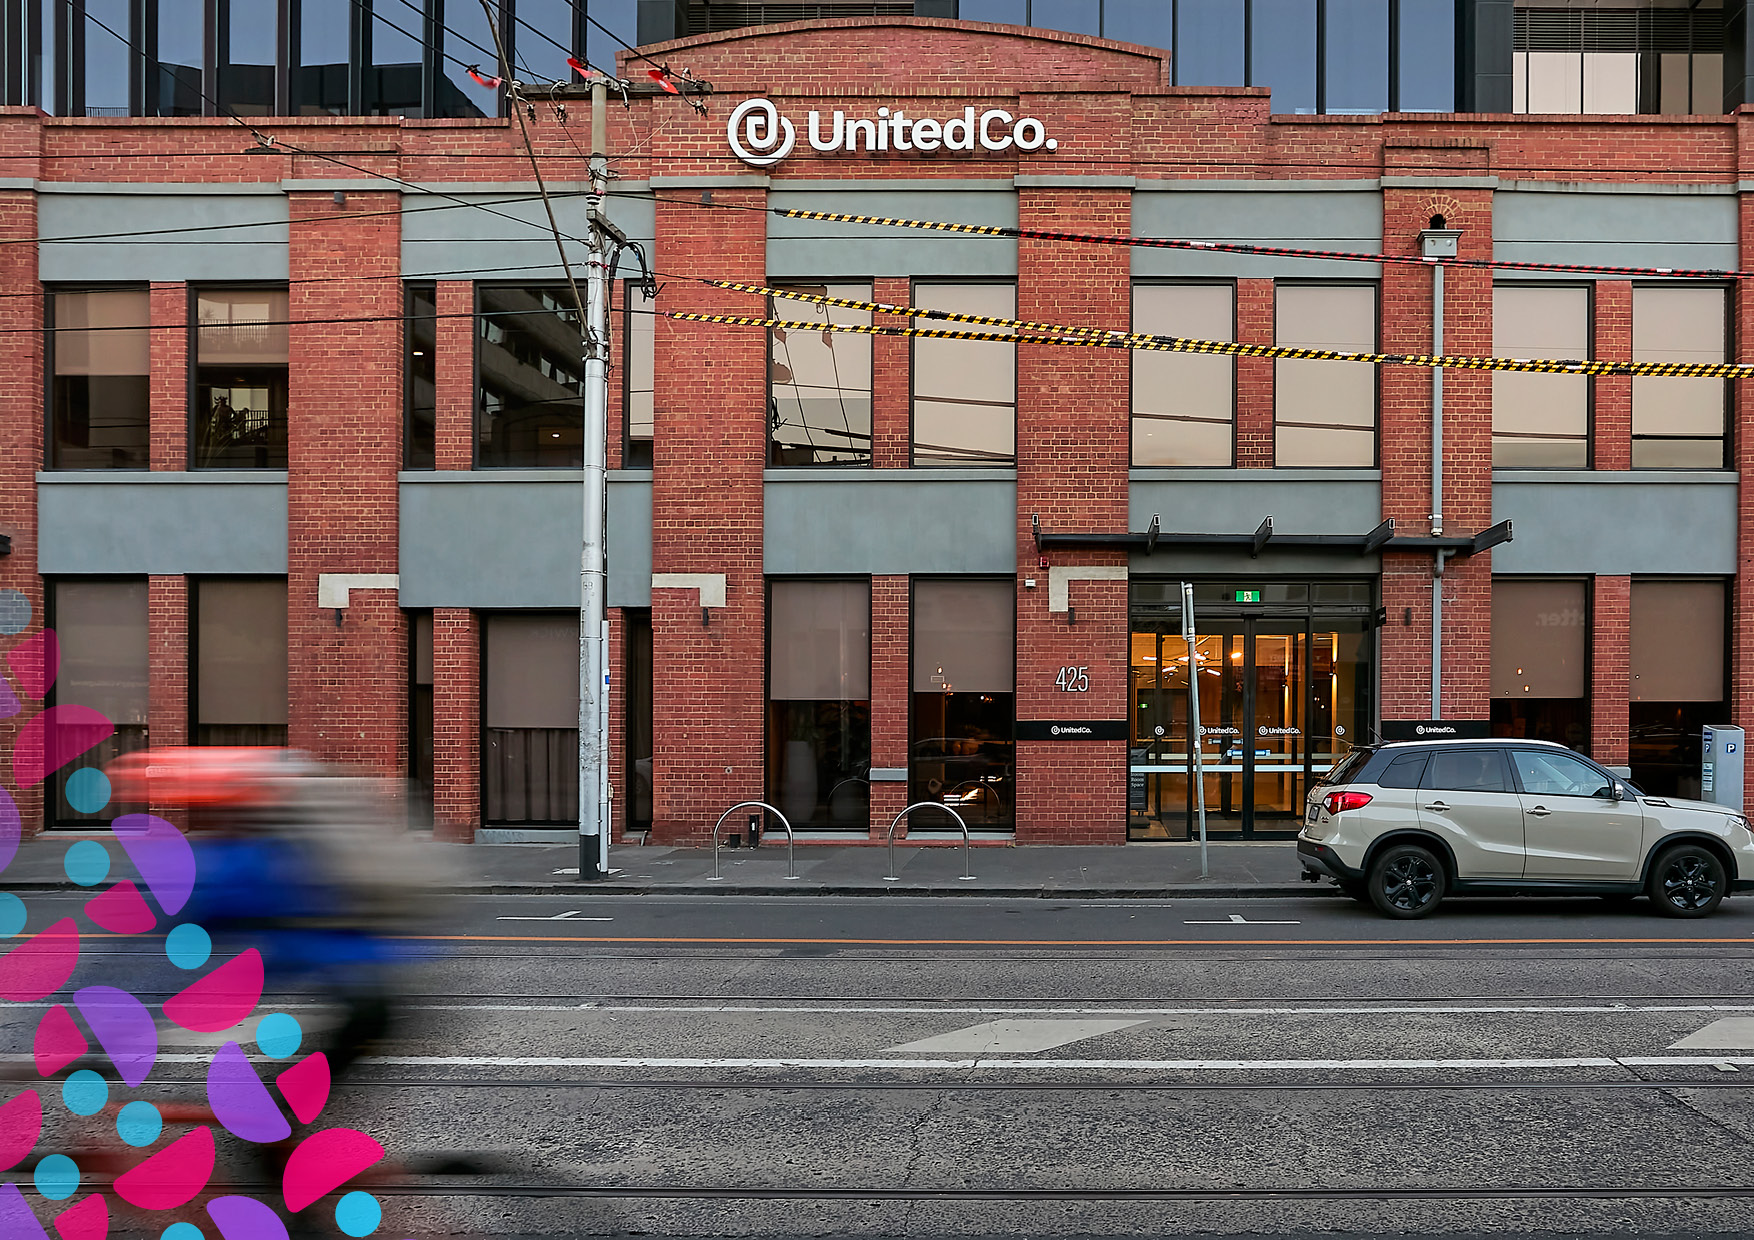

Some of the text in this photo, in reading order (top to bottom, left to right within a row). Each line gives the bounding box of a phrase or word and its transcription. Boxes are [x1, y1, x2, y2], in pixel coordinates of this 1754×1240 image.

[808, 106, 1058, 151] UnitedCo.
[1055, 666, 1089, 692] 425
[1060, 726, 1092, 734] UnitedCo.
[1207, 726, 1240, 734] UnitedCo.
[1268, 726, 1302, 734] UnitedCo.
[1425, 726, 1457, 734] UnitedCo.
[1727, 744, 1736, 753] P
